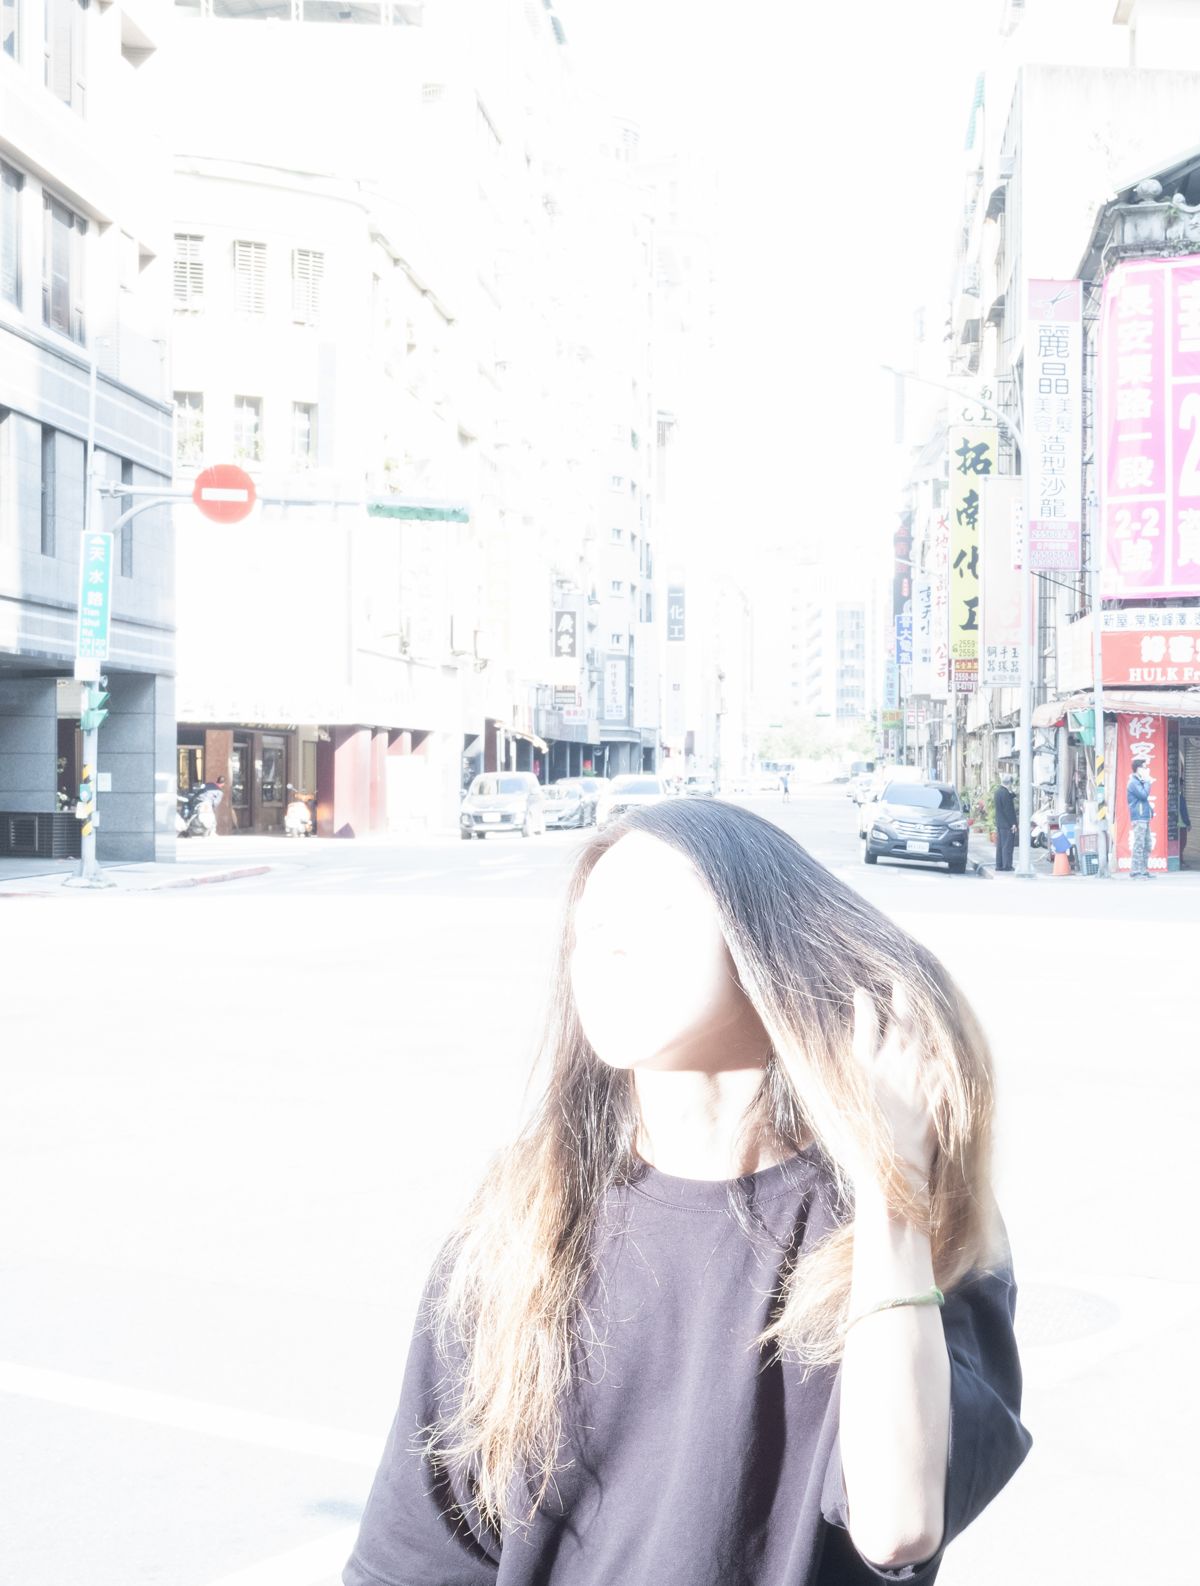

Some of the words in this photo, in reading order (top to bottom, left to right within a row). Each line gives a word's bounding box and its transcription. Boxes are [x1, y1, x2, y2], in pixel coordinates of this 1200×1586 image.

[1116, 285, 1153, 489] 長安東路一段
[1129, 667, 1178, 681] HULK
